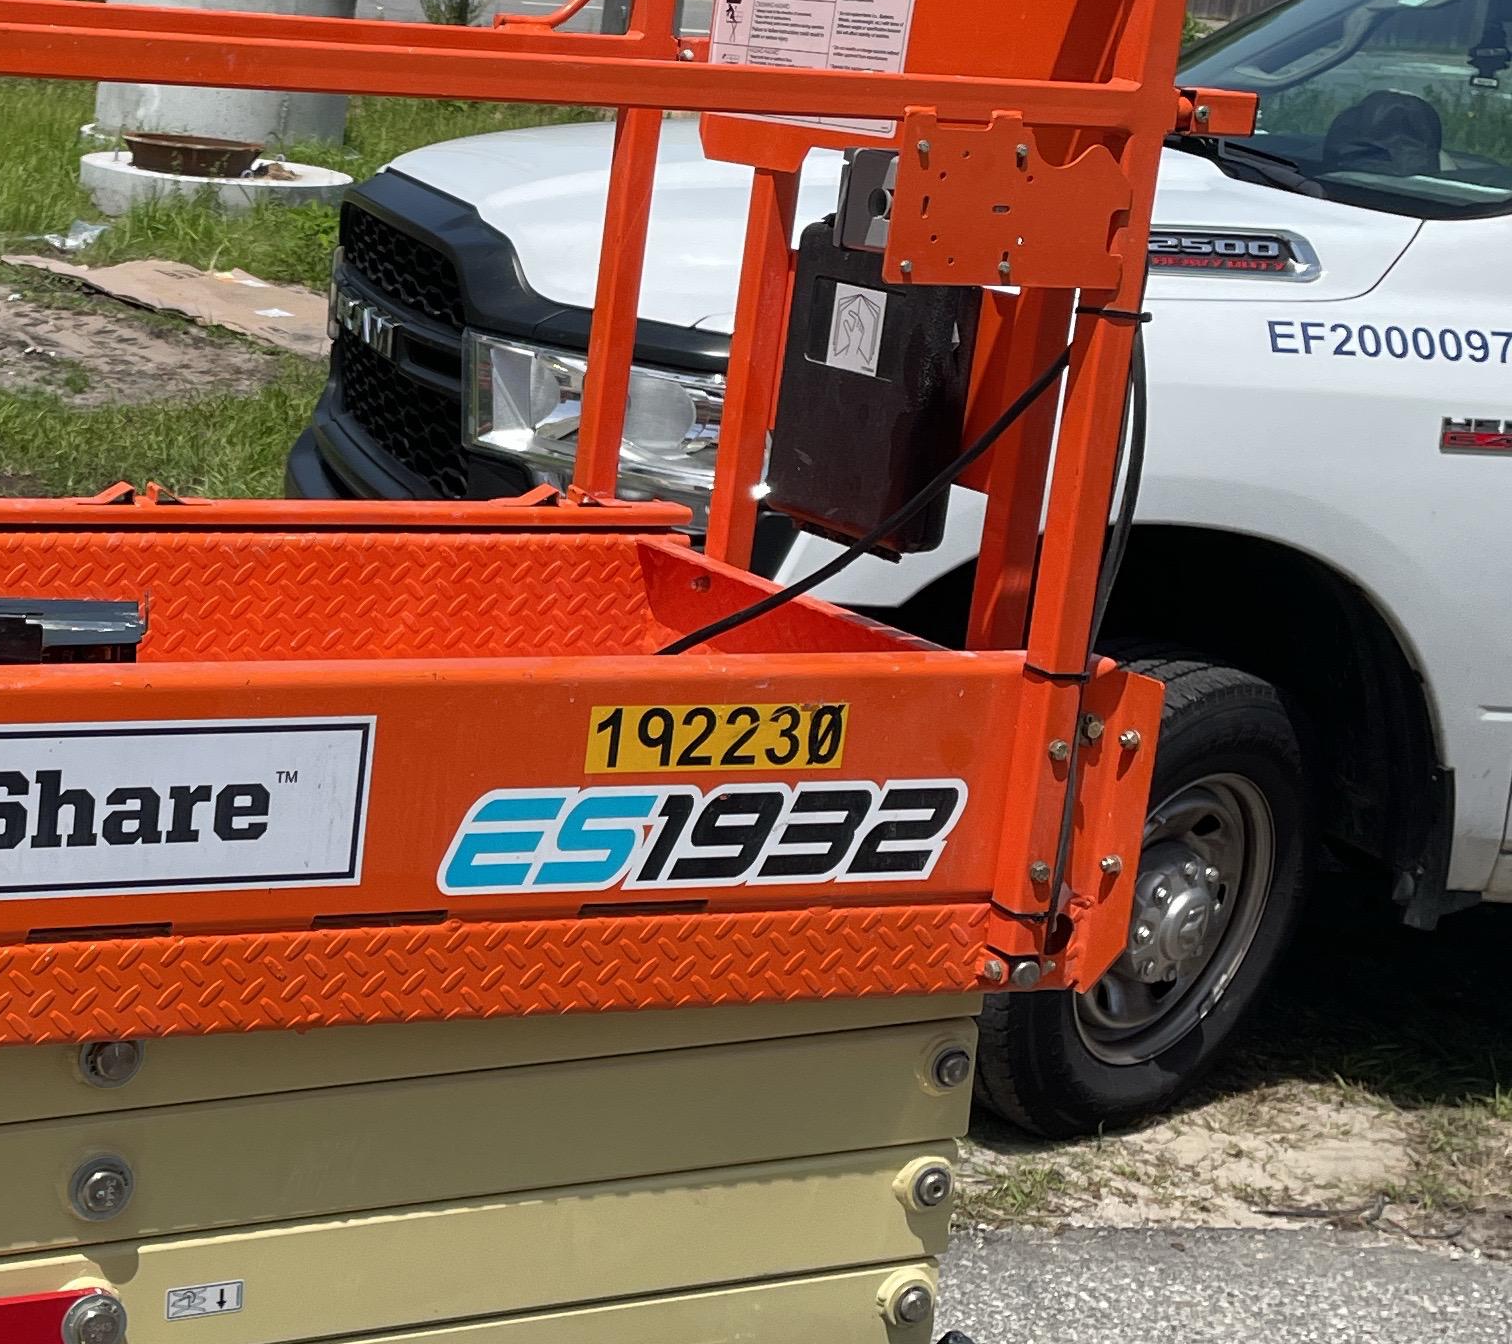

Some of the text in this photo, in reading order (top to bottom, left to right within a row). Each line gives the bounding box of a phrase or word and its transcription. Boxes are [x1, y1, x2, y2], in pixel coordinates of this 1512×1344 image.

[1148, 236, 1280, 257] 2500
[1151, 256, 1287, 271] HEAVY DUTY
[1267, 319, 1512, 364] EF2000097
[596, 703, 846, 769] 192230
[443, 785, 962, 889] ES1932
